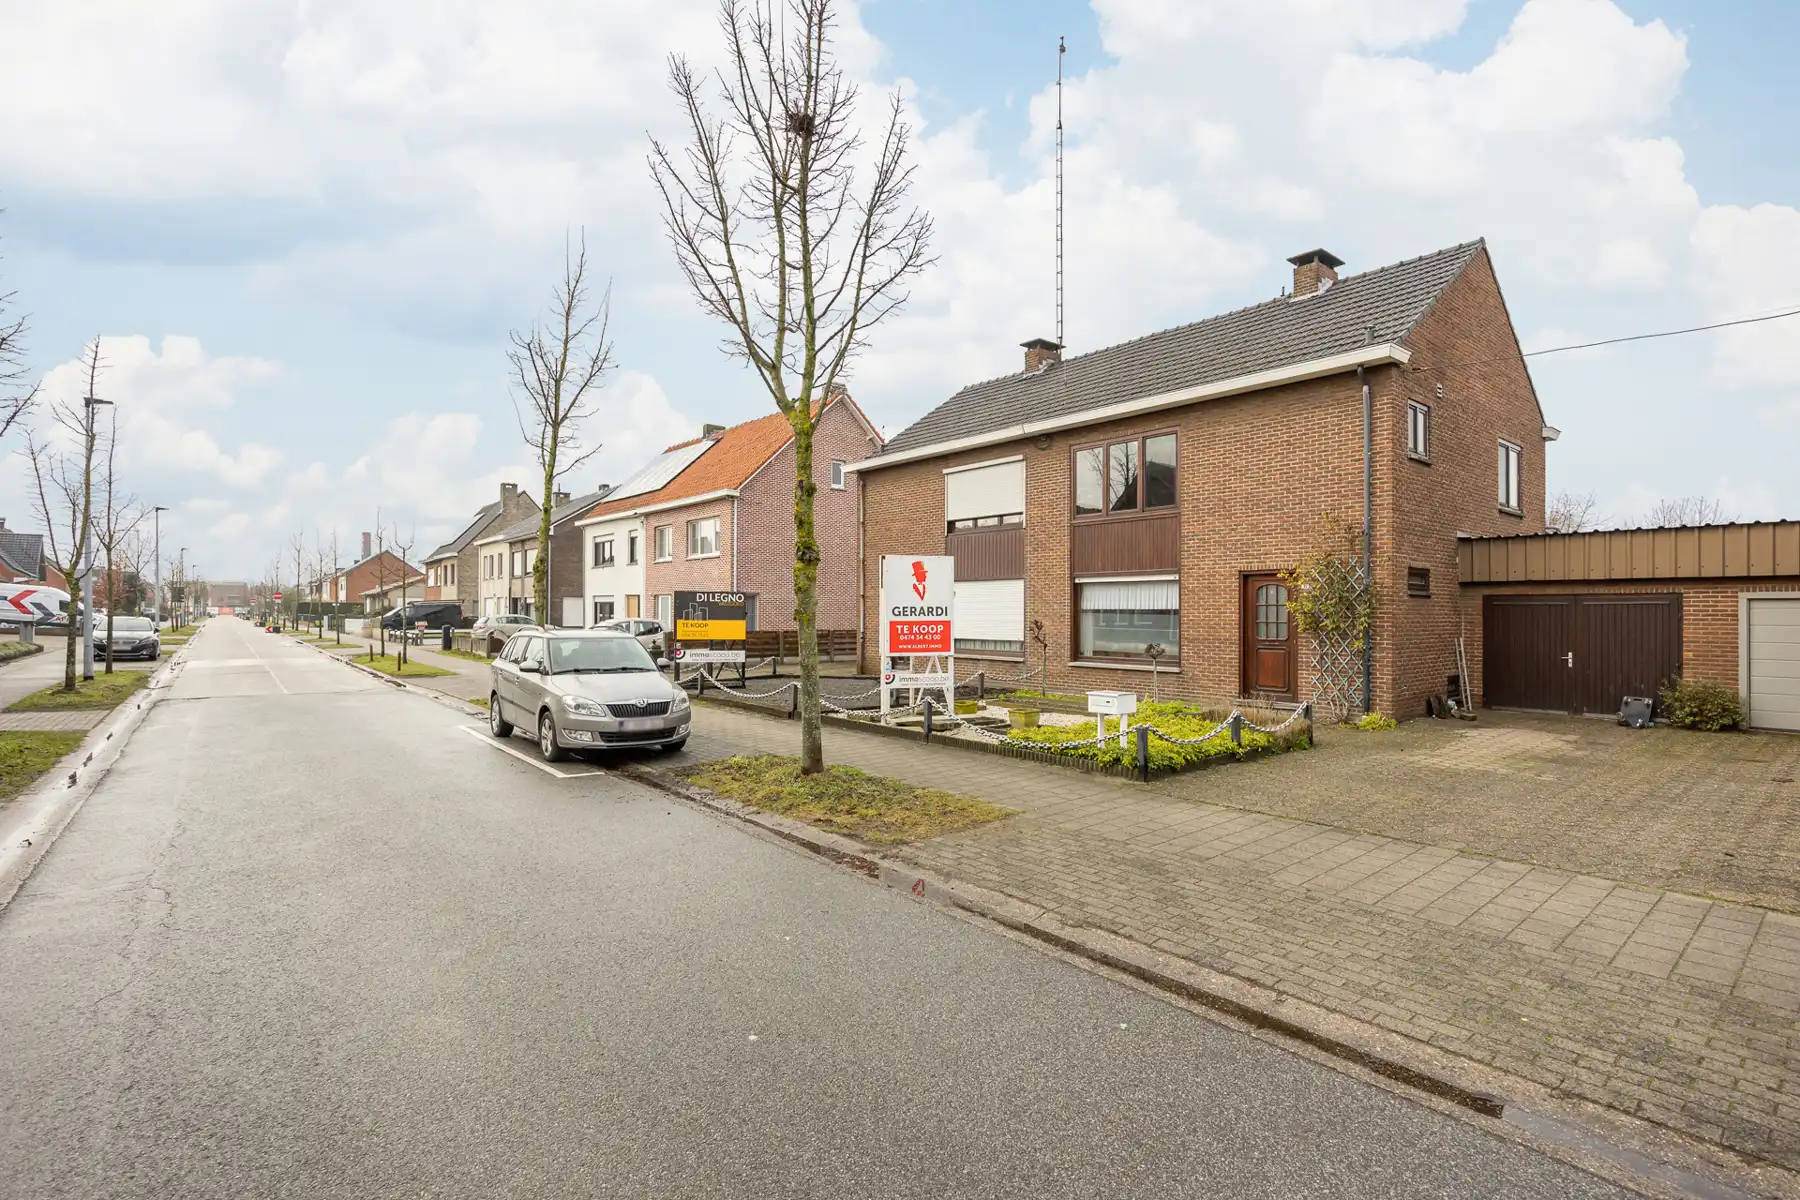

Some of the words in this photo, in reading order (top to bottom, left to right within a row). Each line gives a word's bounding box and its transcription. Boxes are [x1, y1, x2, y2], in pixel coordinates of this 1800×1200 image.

[696, 593, 707, 602] DI
[710, 593, 744, 602] LEGNO
[891, 606, 948, 616] GERARDI
[896, 624, 909, 634] TE
[912, 624, 944, 634] KOOP
